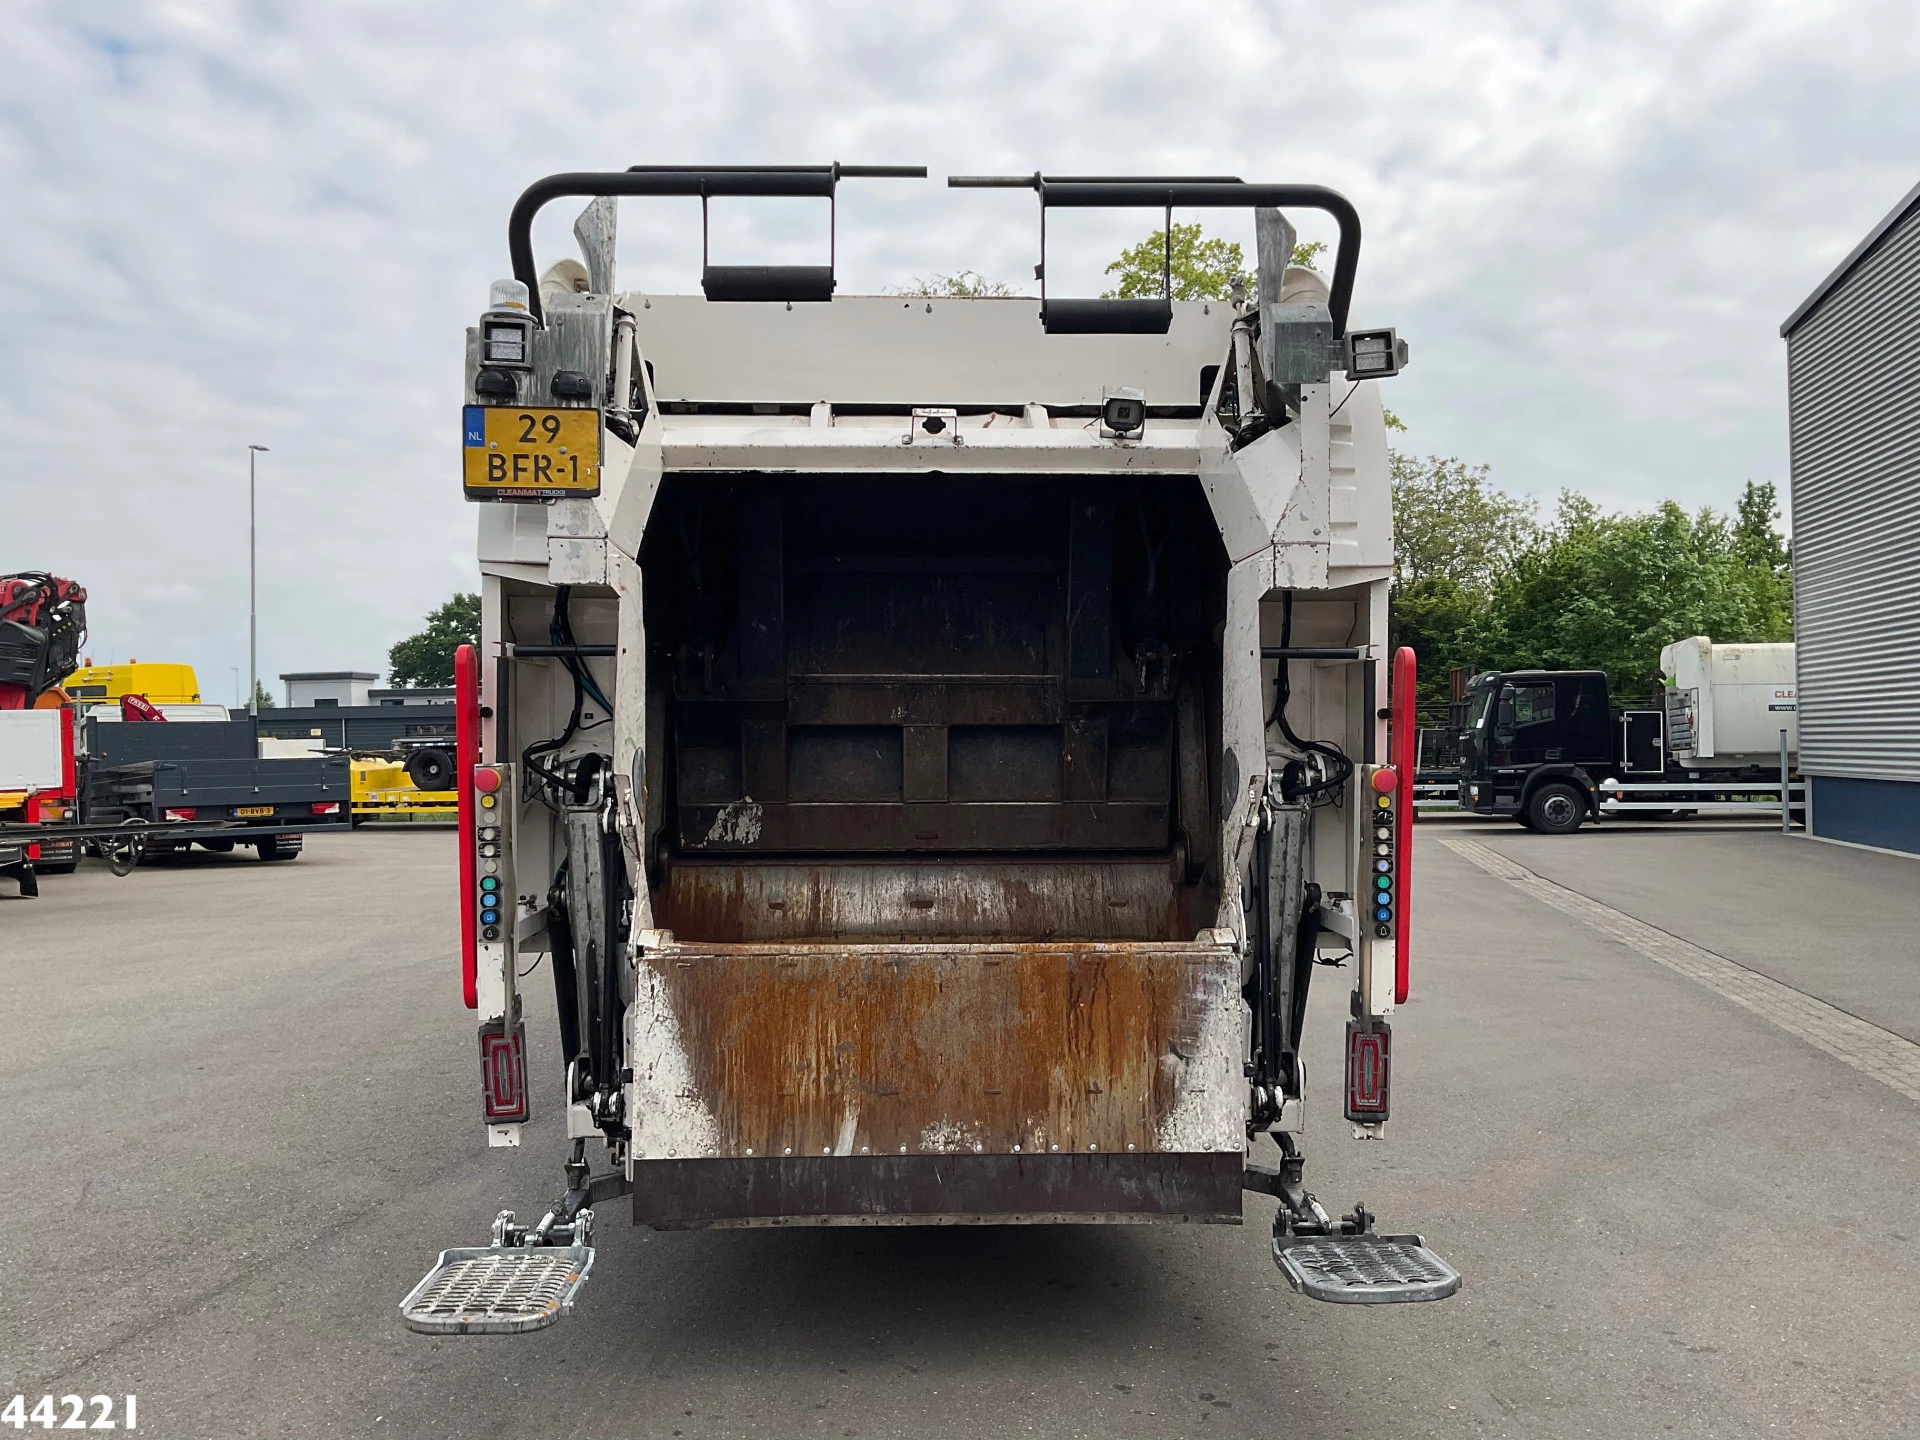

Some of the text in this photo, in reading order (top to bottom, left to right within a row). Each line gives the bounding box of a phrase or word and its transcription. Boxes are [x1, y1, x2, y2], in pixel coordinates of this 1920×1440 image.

[468, 431, 483, 441] NL
[518, 413, 561, 444] 29
[487, 453, 578, 483] BFR-1
[1774, 690, 1797, 699] CLE
